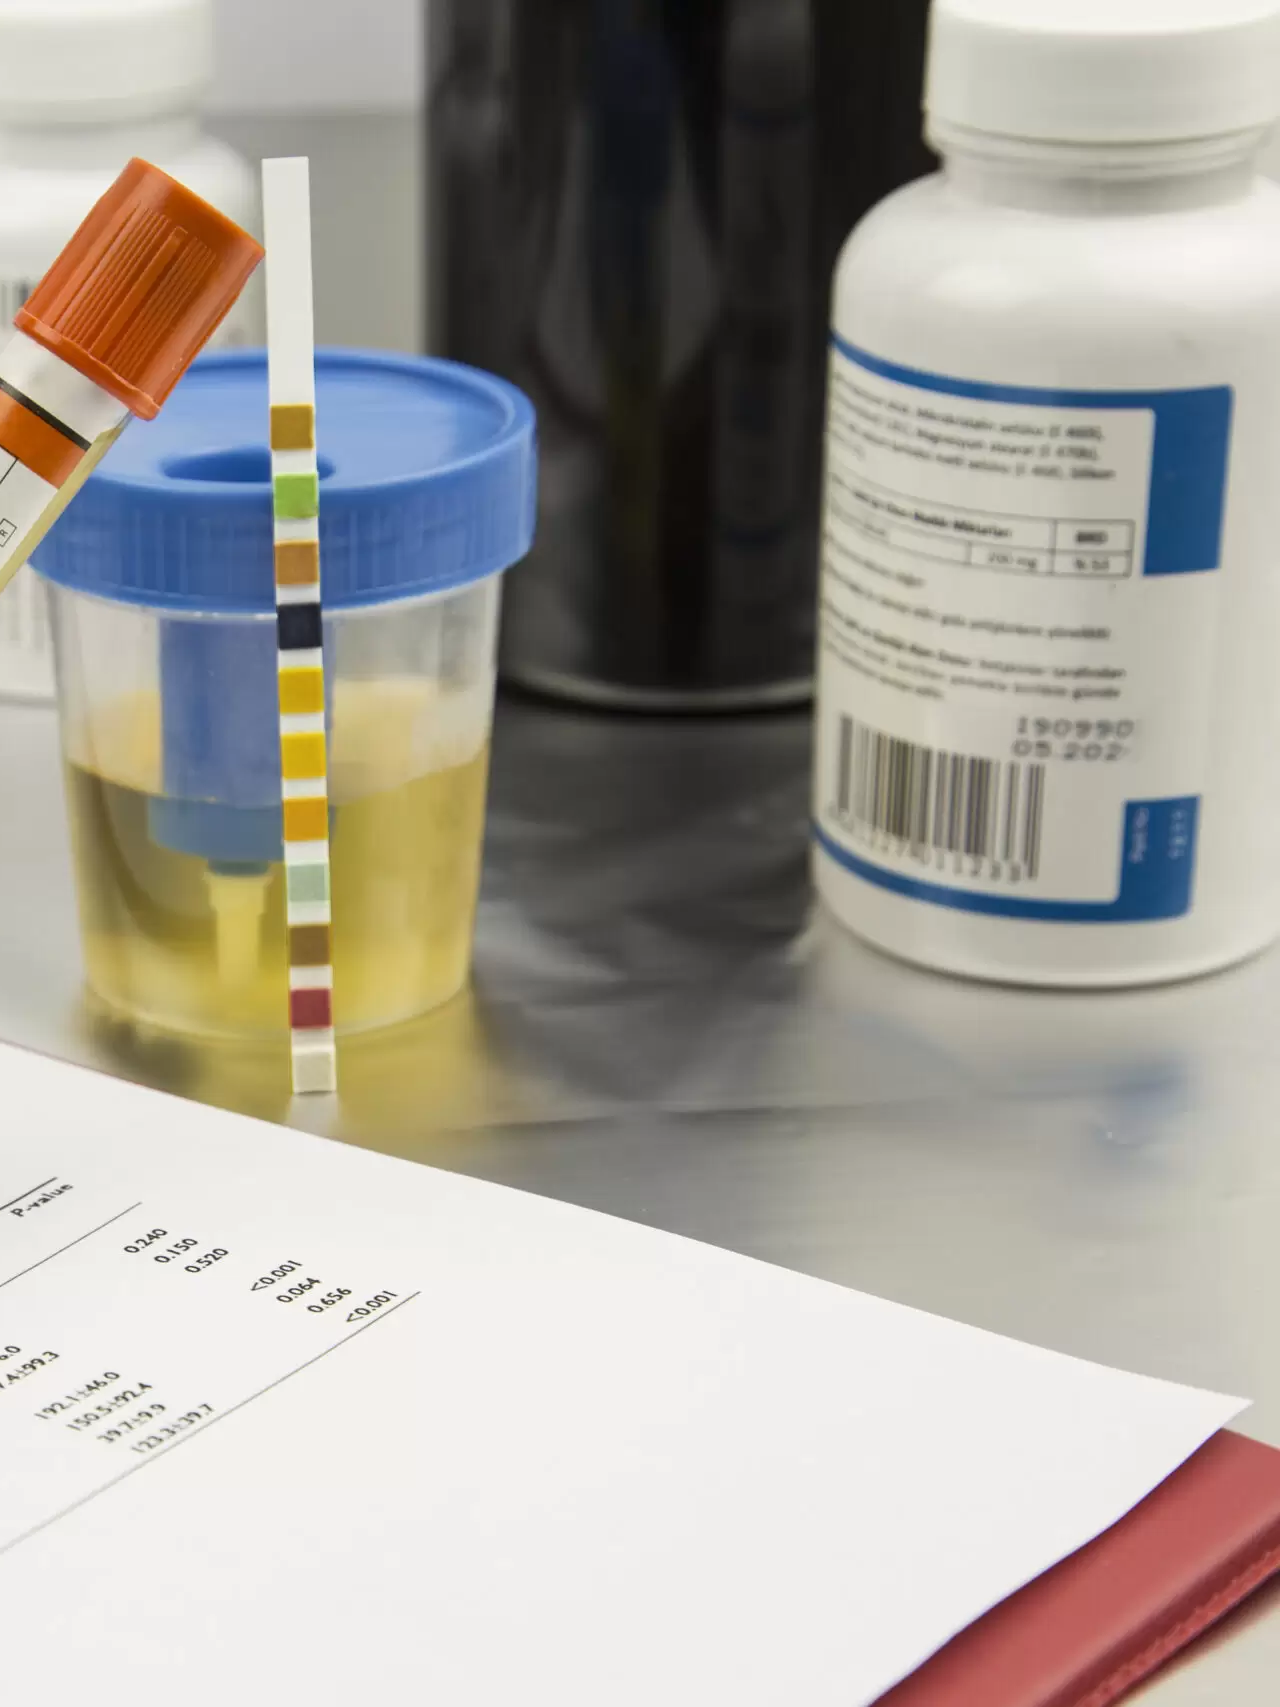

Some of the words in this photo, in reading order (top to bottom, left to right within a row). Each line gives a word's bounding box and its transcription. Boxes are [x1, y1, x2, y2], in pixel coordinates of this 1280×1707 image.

[10, 1182, 74, 1218] P-value
[123, 1228, 168, 1255] 0.240
[153, 1238, 199, 1265] 0.150
[184, 1248, 229, 1274] 0.520
[249, 1259, 304, 1293] <0.001
[276, 1277, 322, 1304] 0.064
[307, 1287, 353, 1314] 0.656
[345, 1290, 399, 1324] <0.001
[33, 1371, 120, 1420] 192.1±46.0
